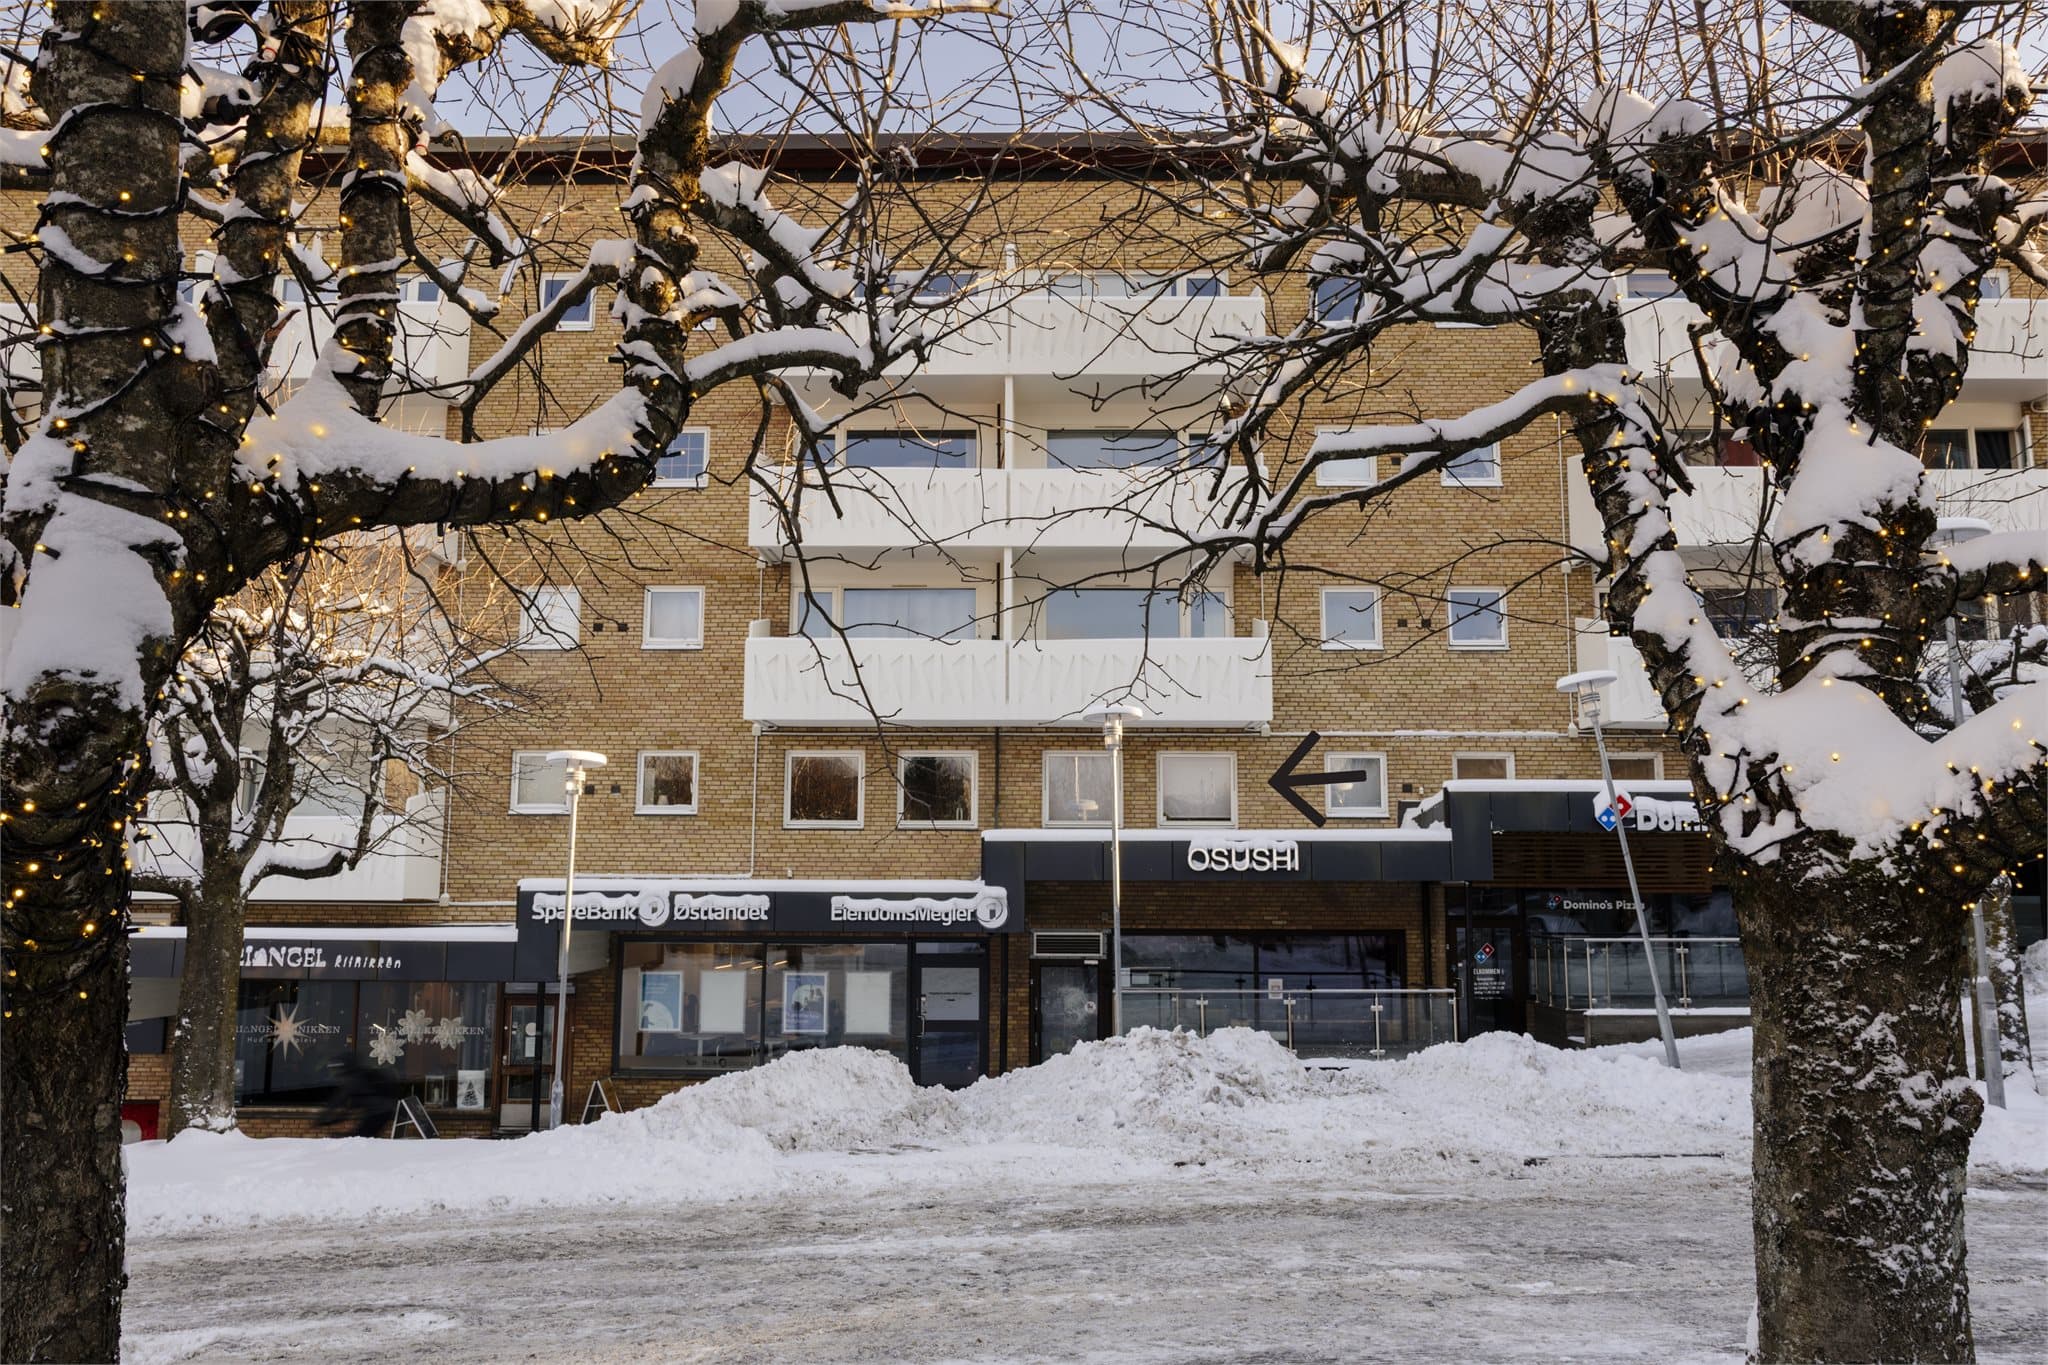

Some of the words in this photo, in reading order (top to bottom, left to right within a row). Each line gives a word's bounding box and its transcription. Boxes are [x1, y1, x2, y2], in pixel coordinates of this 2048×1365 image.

[1188, 847, 1299, 871] OSUSHI
[1563, 900, 1613, 910] Domino's
[240, 945, 327, 967] IANGEL
